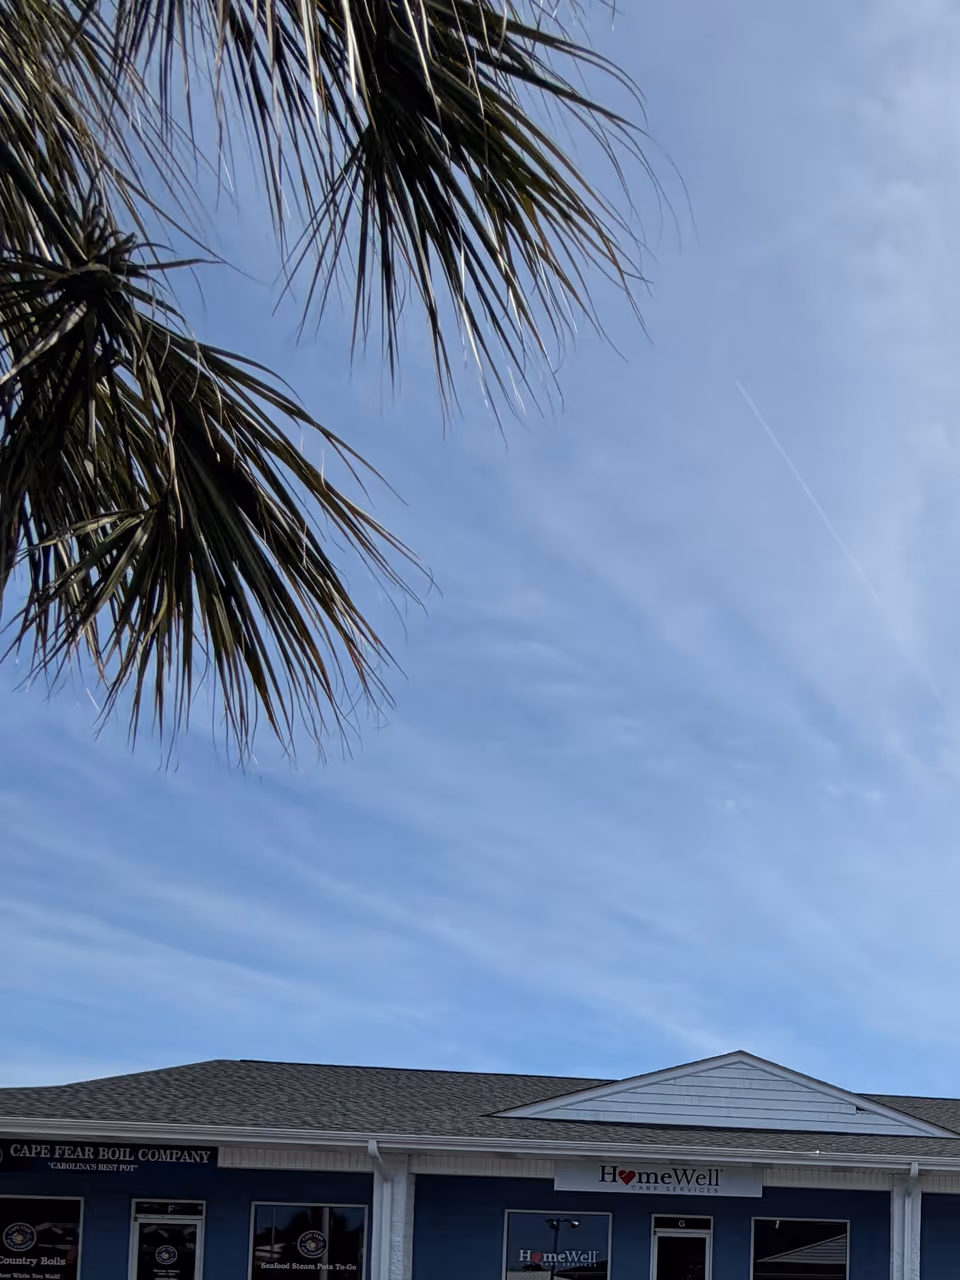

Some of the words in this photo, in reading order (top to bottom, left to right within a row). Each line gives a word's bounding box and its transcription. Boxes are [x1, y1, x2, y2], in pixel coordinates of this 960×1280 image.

[10, 1144, 50, 1158] CAPE
[54, 1145, 94, 1159] FEAR
[97, 1146, 134, 1161] BOIL
[137, 1148, 211, 1164] COMPANY
[98, 1163, 118, 1171] BEST
[666, 1186, 719, 1194] SERVICES
[678, 1220, 686, 1228] G
[40, 1256, 67, 1266] Boils
[260, 1262, 290, 1270] Seafood
[291, 1262, 315, 1270] Steam
